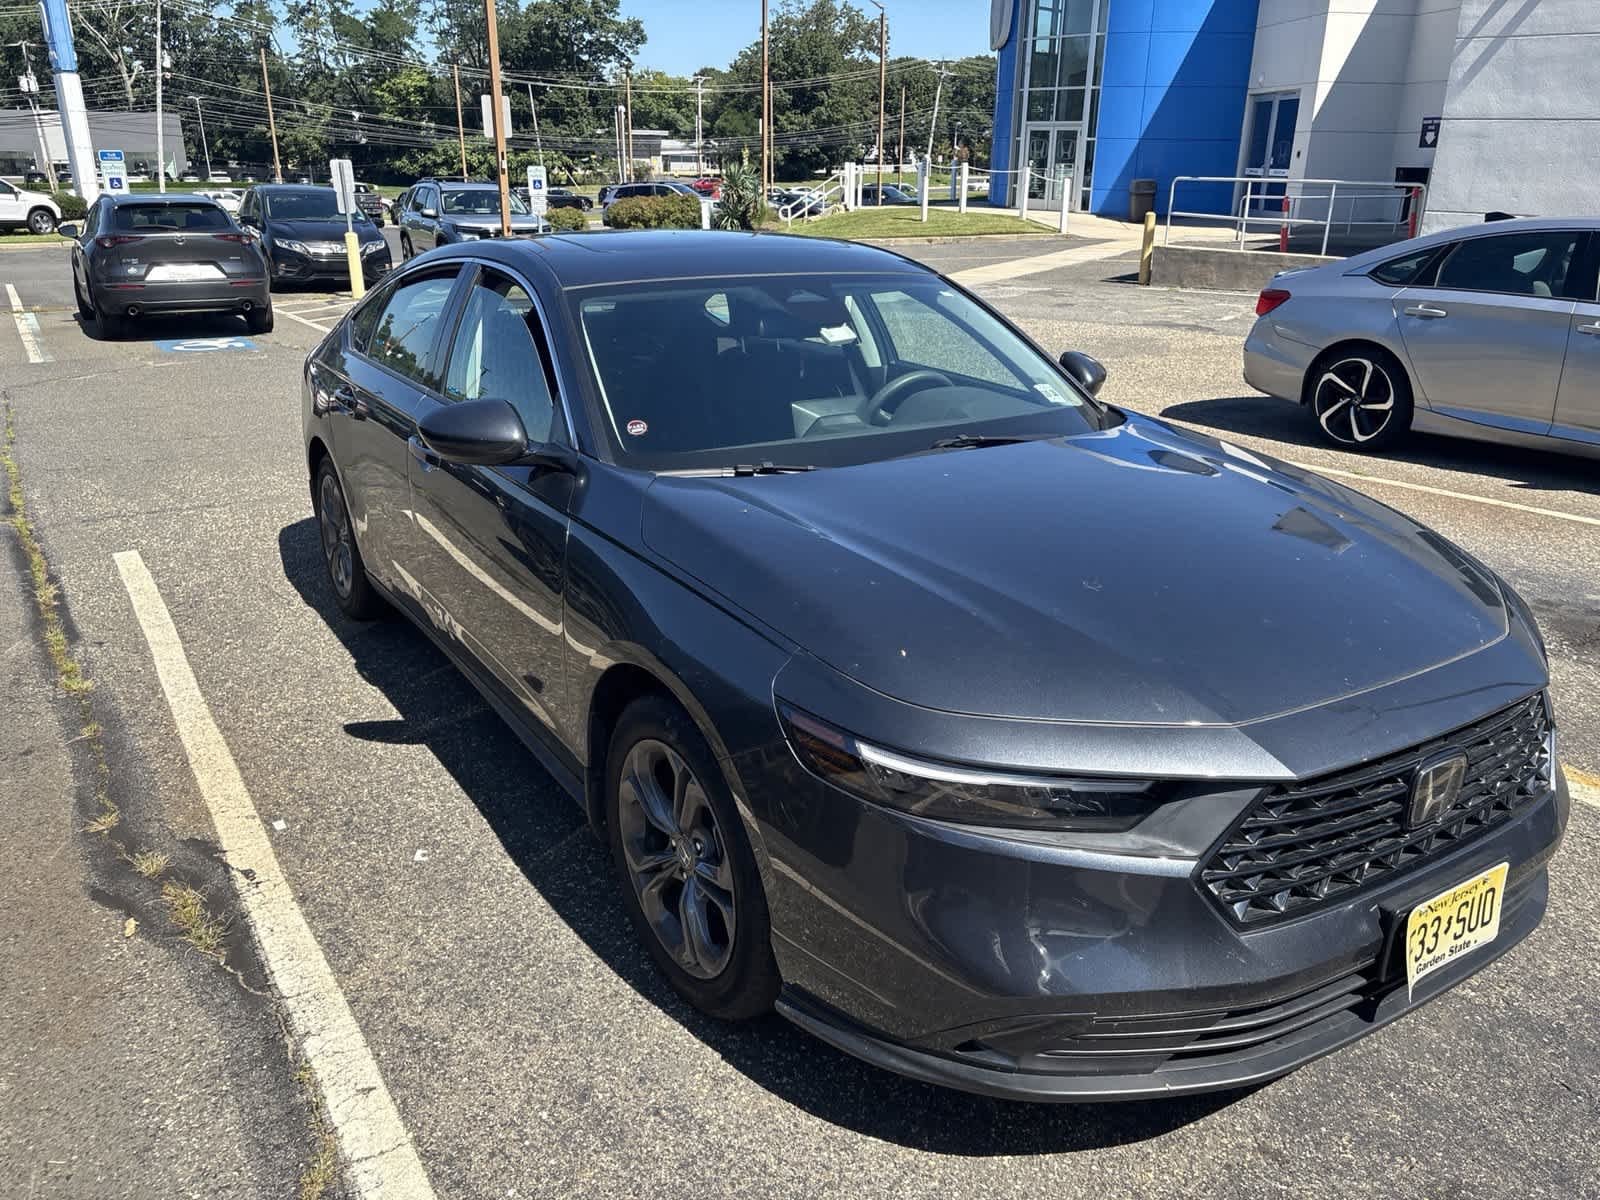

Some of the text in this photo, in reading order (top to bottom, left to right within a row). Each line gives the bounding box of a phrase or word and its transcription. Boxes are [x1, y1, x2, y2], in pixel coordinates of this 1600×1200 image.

[1427, 882, 1481, 915] New Jersey
[1416, 940, 1471, 975] Garden State
